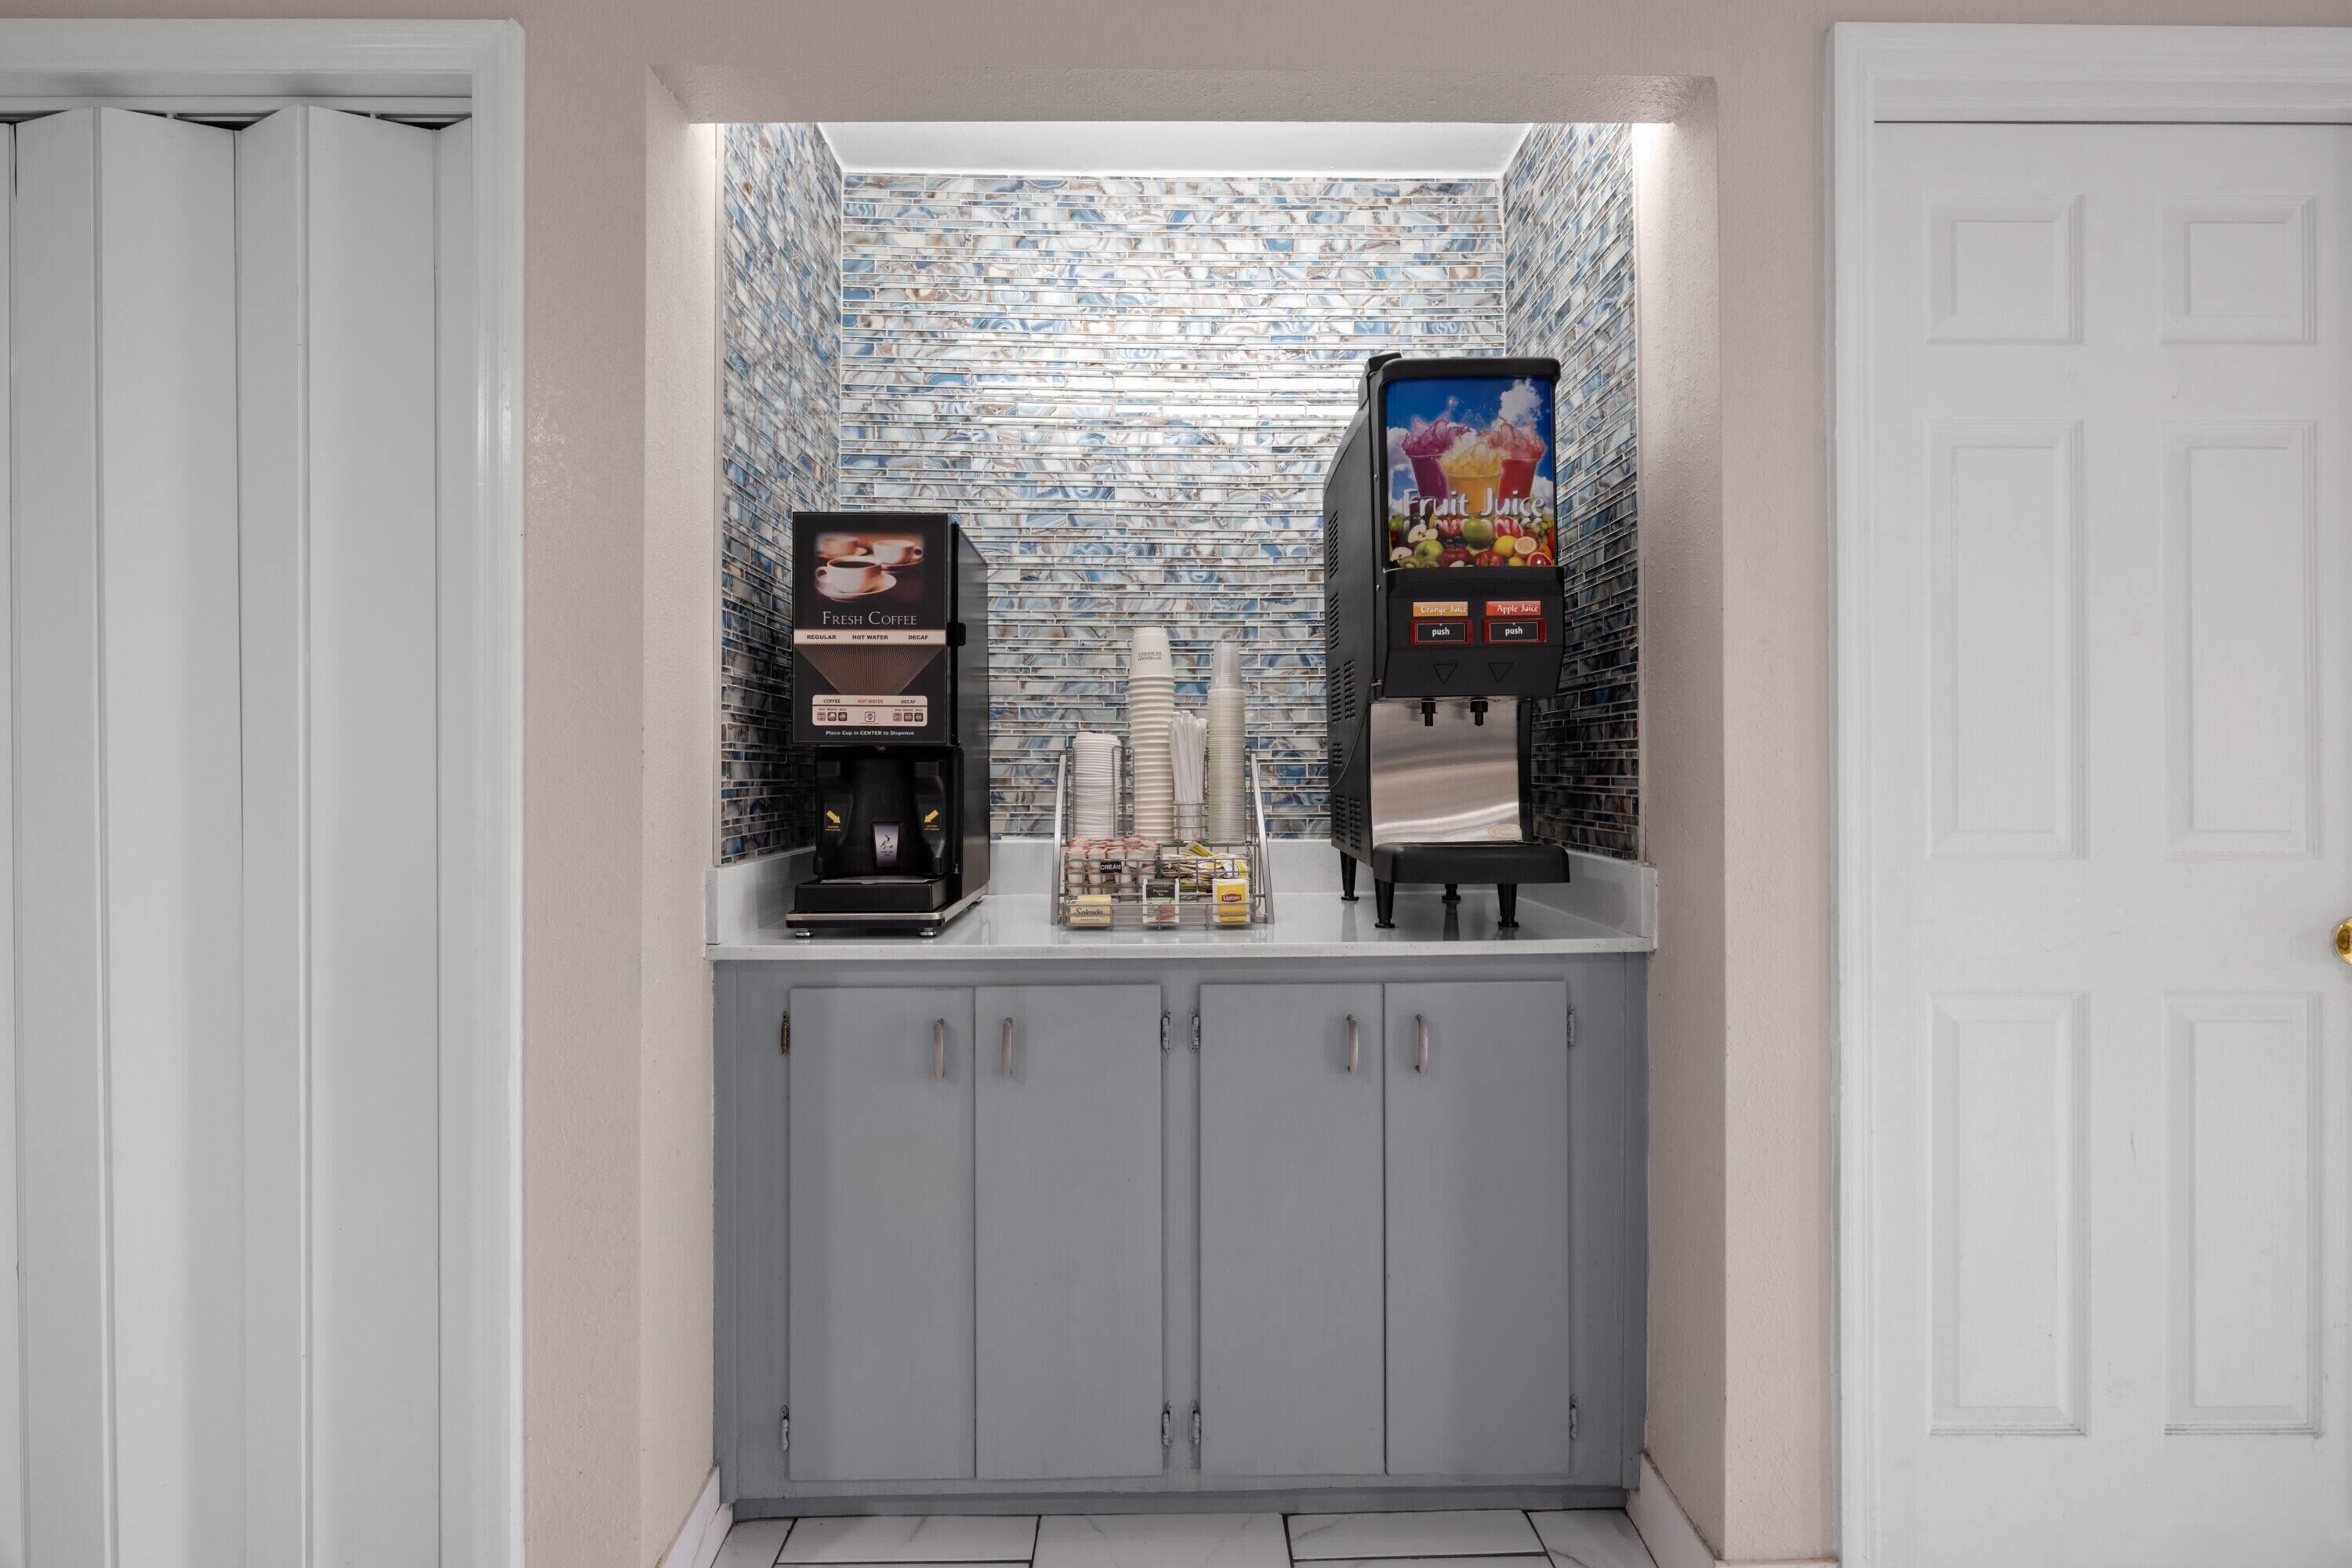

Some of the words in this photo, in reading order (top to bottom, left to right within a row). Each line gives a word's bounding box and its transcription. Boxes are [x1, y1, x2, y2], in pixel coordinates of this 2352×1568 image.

[1403, 488, 1469, 517] Fruit
[1480, 488, 1546, 517] Juice
[1420, 604, 1447, 615] Orange
[1450, 604, 1468, 614] Juice
[1497, 604, 1519, 615] Apple
[1520, 604, 1539, 613] Juice
[1432, 627, 1450, 637] push
[1504, 626, 1523, 637] push
[1100, 863, 1121, 872] CREAM
[1073, 907, 1104, 917] Splenda
